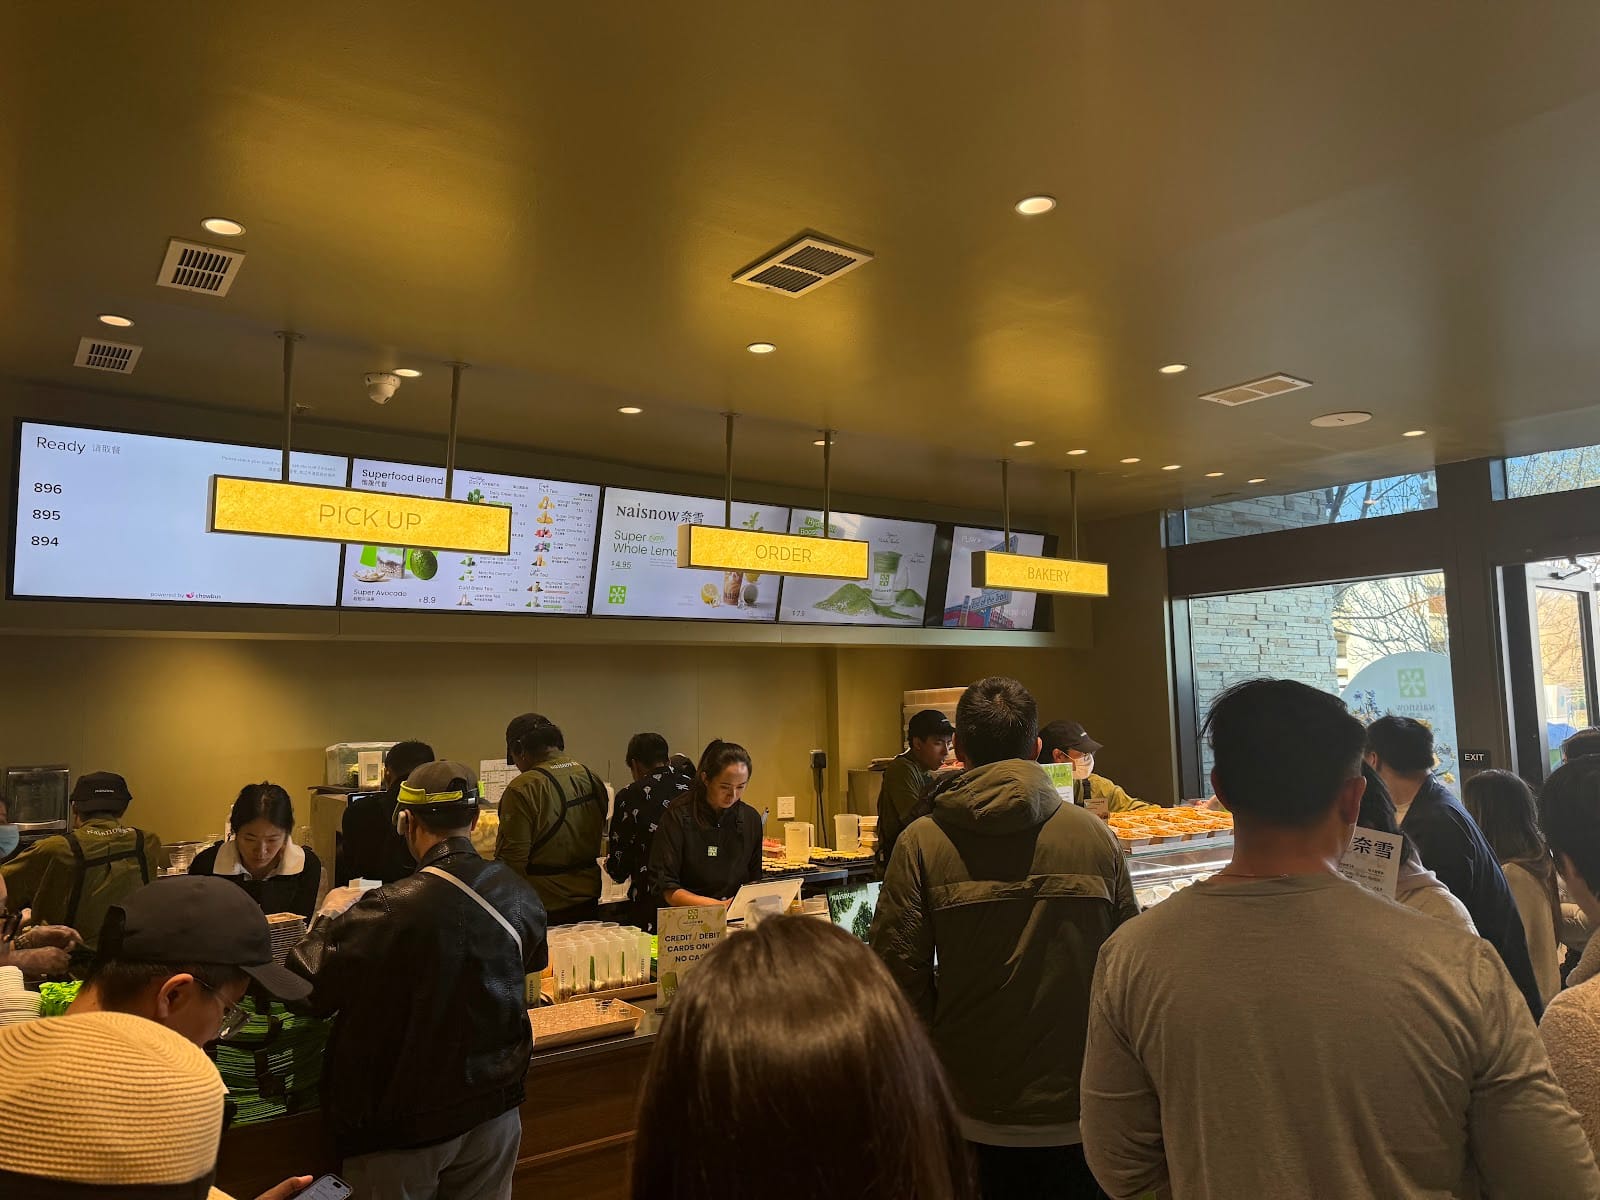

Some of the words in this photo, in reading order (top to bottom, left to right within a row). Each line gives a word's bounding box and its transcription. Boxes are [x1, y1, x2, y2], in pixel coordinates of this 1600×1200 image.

[36, 436, 86, 455] Ready
[362, 469, 414, 481] Superfood
[416, 475, 444, 485] Blend
[33, 482, 62, 495] 896
[32, 509, 61, 521] 895
[319, 503, 379, 528] PICK
[386, 510, 422, 530] UP
[681, 510, 705, 524] 奈雪
[31, 536, 60, 547] 894
[614, 529, 647, 544] Super
[613, 542, 648, 555] Whole
[650, 545, 678, 557] Lemo
[755, 544, 812, 563] ORDER
[1027, 566, 1070, 582] BAKERY
[353, 588, 375, 597] Super
[375, 589, 408, 597] Avocado
[1464, 753, 1484, 761] EXIT
[1352, 836, 1395, 860] 奈雪
[664, 934, 692, 942] CREDIT
[699, 931, 721, 940] DEBIT
[667, 943, 695, 953] CARDS
[696, 942, 716, 950] ONL
